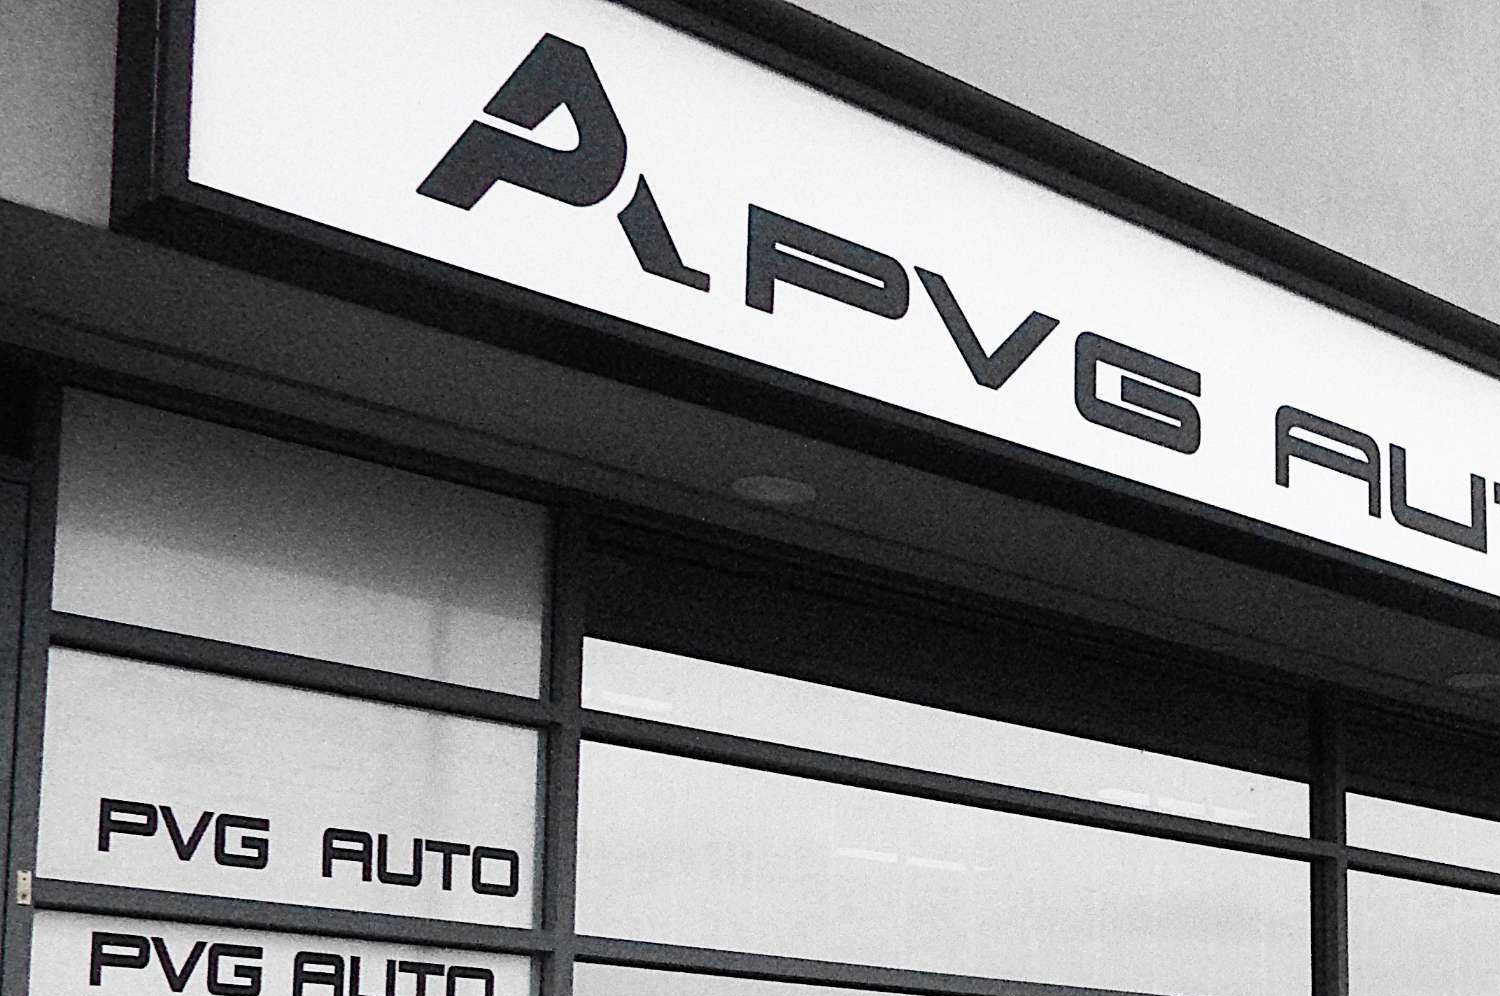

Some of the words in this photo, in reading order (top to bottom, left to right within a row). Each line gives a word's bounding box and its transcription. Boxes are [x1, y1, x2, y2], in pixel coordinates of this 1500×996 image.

[745, 204, 1201, 454] PVG
[98, 797, 270, 870] PVG
[322, 827, 520, 898] AUTO
